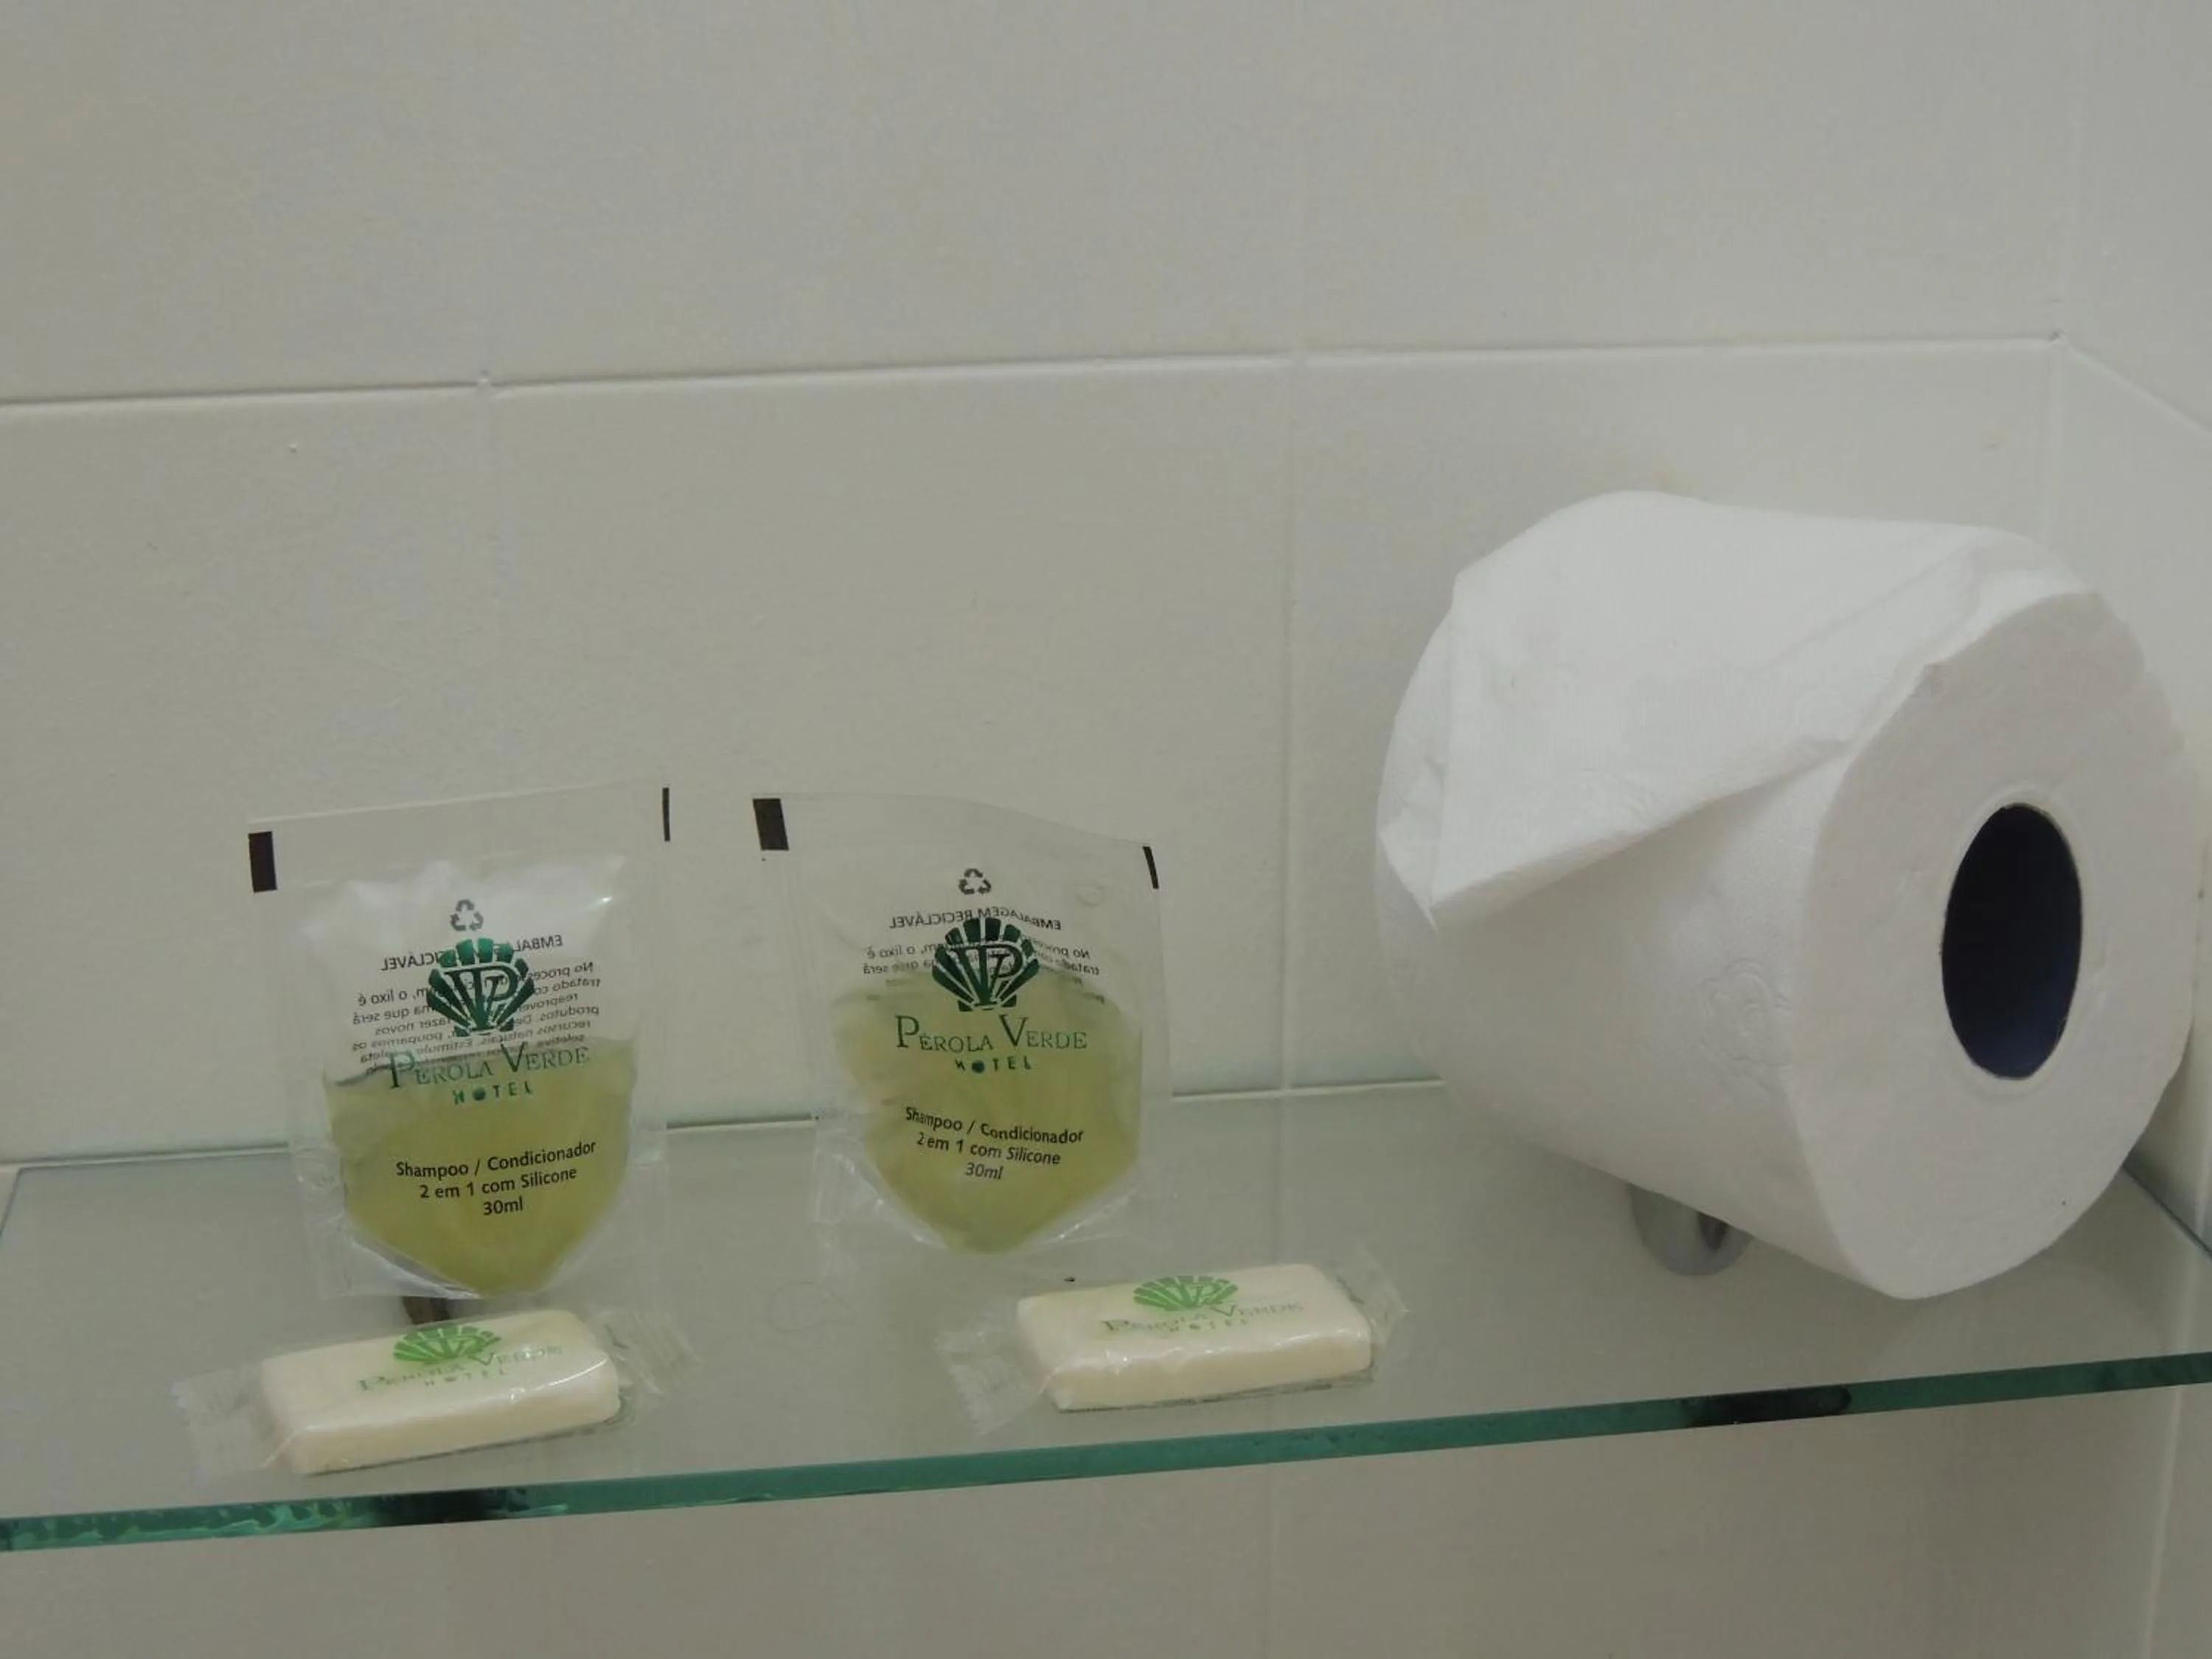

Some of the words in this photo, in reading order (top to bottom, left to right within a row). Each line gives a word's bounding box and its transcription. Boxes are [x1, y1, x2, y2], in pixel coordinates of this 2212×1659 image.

[999, 1013, 1088, 1049] VERDE
[500, 1041, 590, 1072] VERDE
[955, 1055, 1032, 1073] HOTEL
[452, 1081, 533, 1105] HOTEL
[905, 1107, 962, 1132] Shampoo
[967, 1121, 975, 1134] /
[981, 1123, 1084, 1144] Condicionador
[396, 1161, 468, 1180] Shampoo
[473, 1160, 481, 1176] /
[487, 1141, 597, 1171] Condicionador
[916, 1132, 924, 1146] 2
[927, 1138, 950, 1151] em
[956, 1139, 963, 1153] 1
[970, 1143, 1001, 1158] com
[1006, 1147, 1061, 1165] Silicone
[420, 1185, 430, 1198] 2
[435, 1186, 460, 1199] em
[467, 1182, 474, 1196] 1
[481, 1180, 515, 1194] com
[521, 1168, 577, 1189] Silicone
[964, 1161, 1004, 1180] 30ml
[483, 1197, 524, 1216] 30ml
